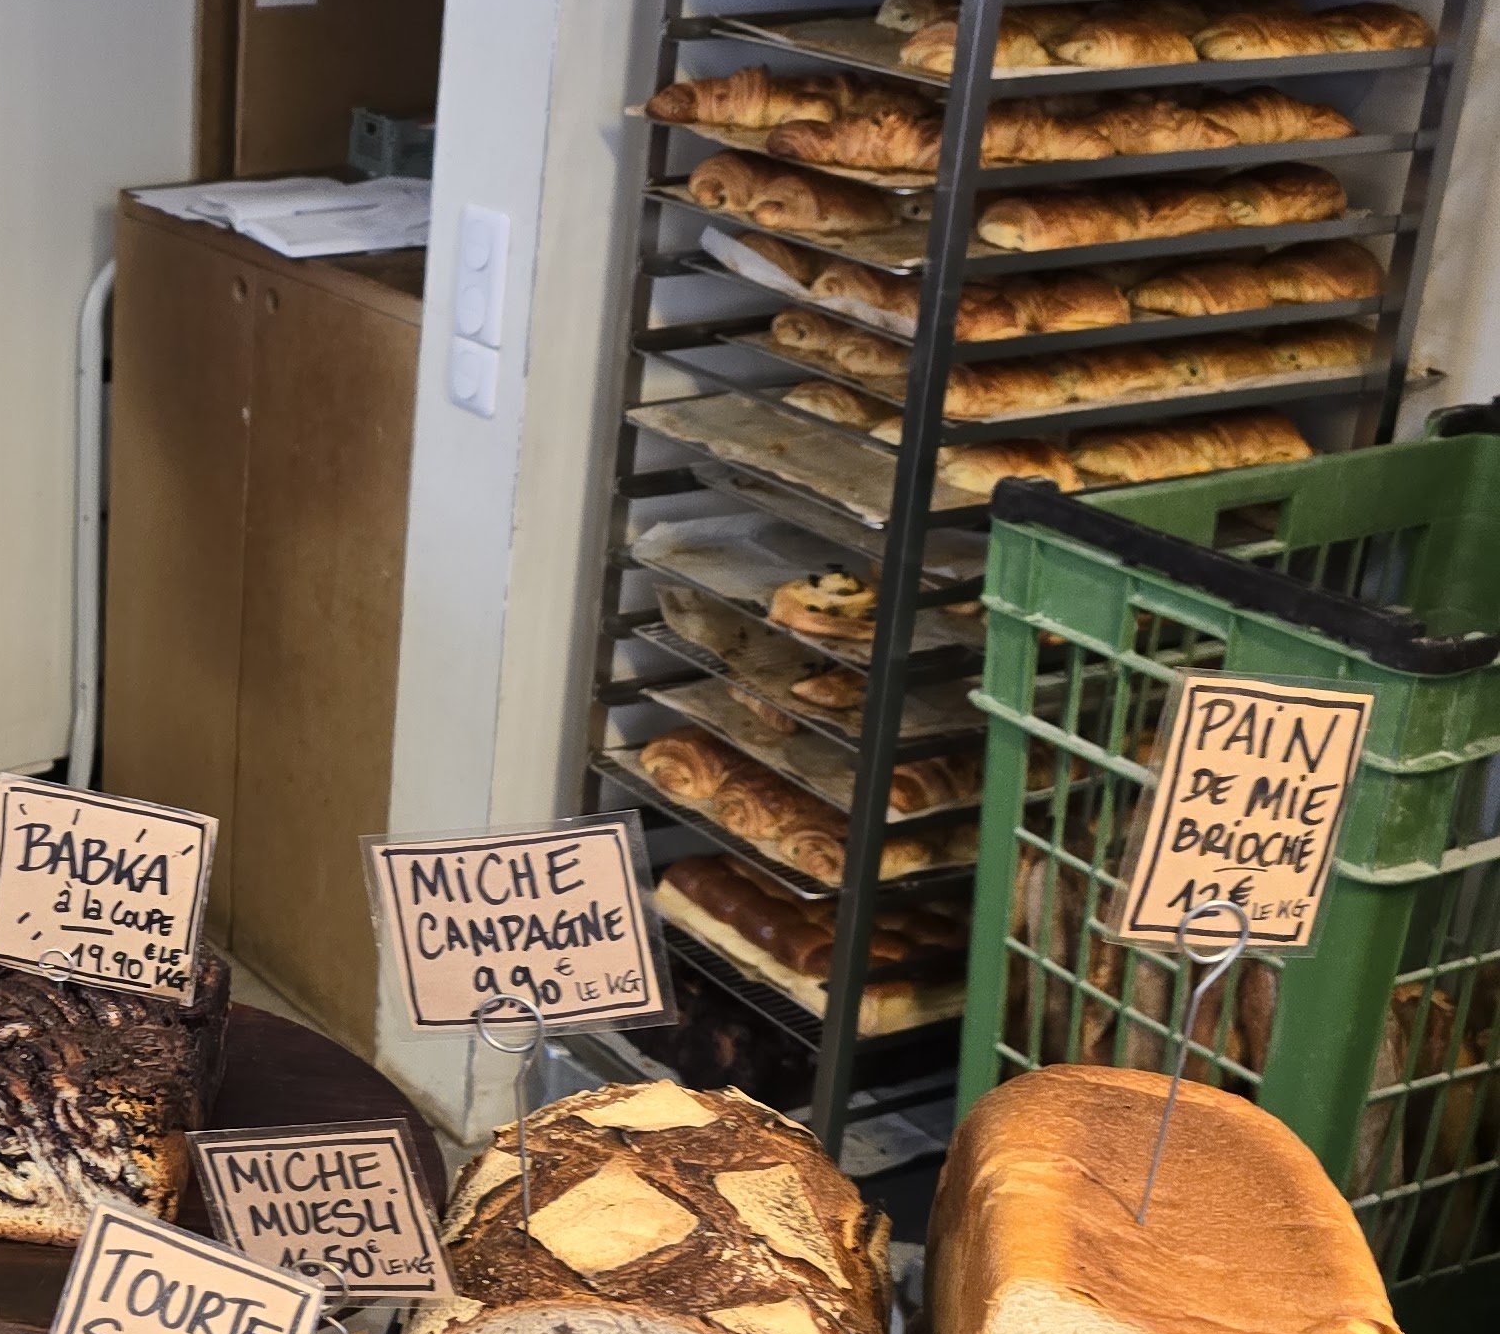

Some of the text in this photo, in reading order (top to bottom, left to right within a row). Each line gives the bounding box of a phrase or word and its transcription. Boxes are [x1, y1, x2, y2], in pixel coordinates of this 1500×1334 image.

[1197, 698, 1341, 773] PAiN
[1180, 768, 1338, 825] DE MiE
[14, 823, 168, 895] BABKA
[411, 843, 585, 905] MiCHE
[54, 881, 72, 912] à
[83, 889, 102, 920] la
[418, 901, 624, 959] CAMPAGNE
[575, 980, 600, 1001] LE
[605, 969, 642, 995] KG
[226, 1151, 382, 1194] MiCHE
